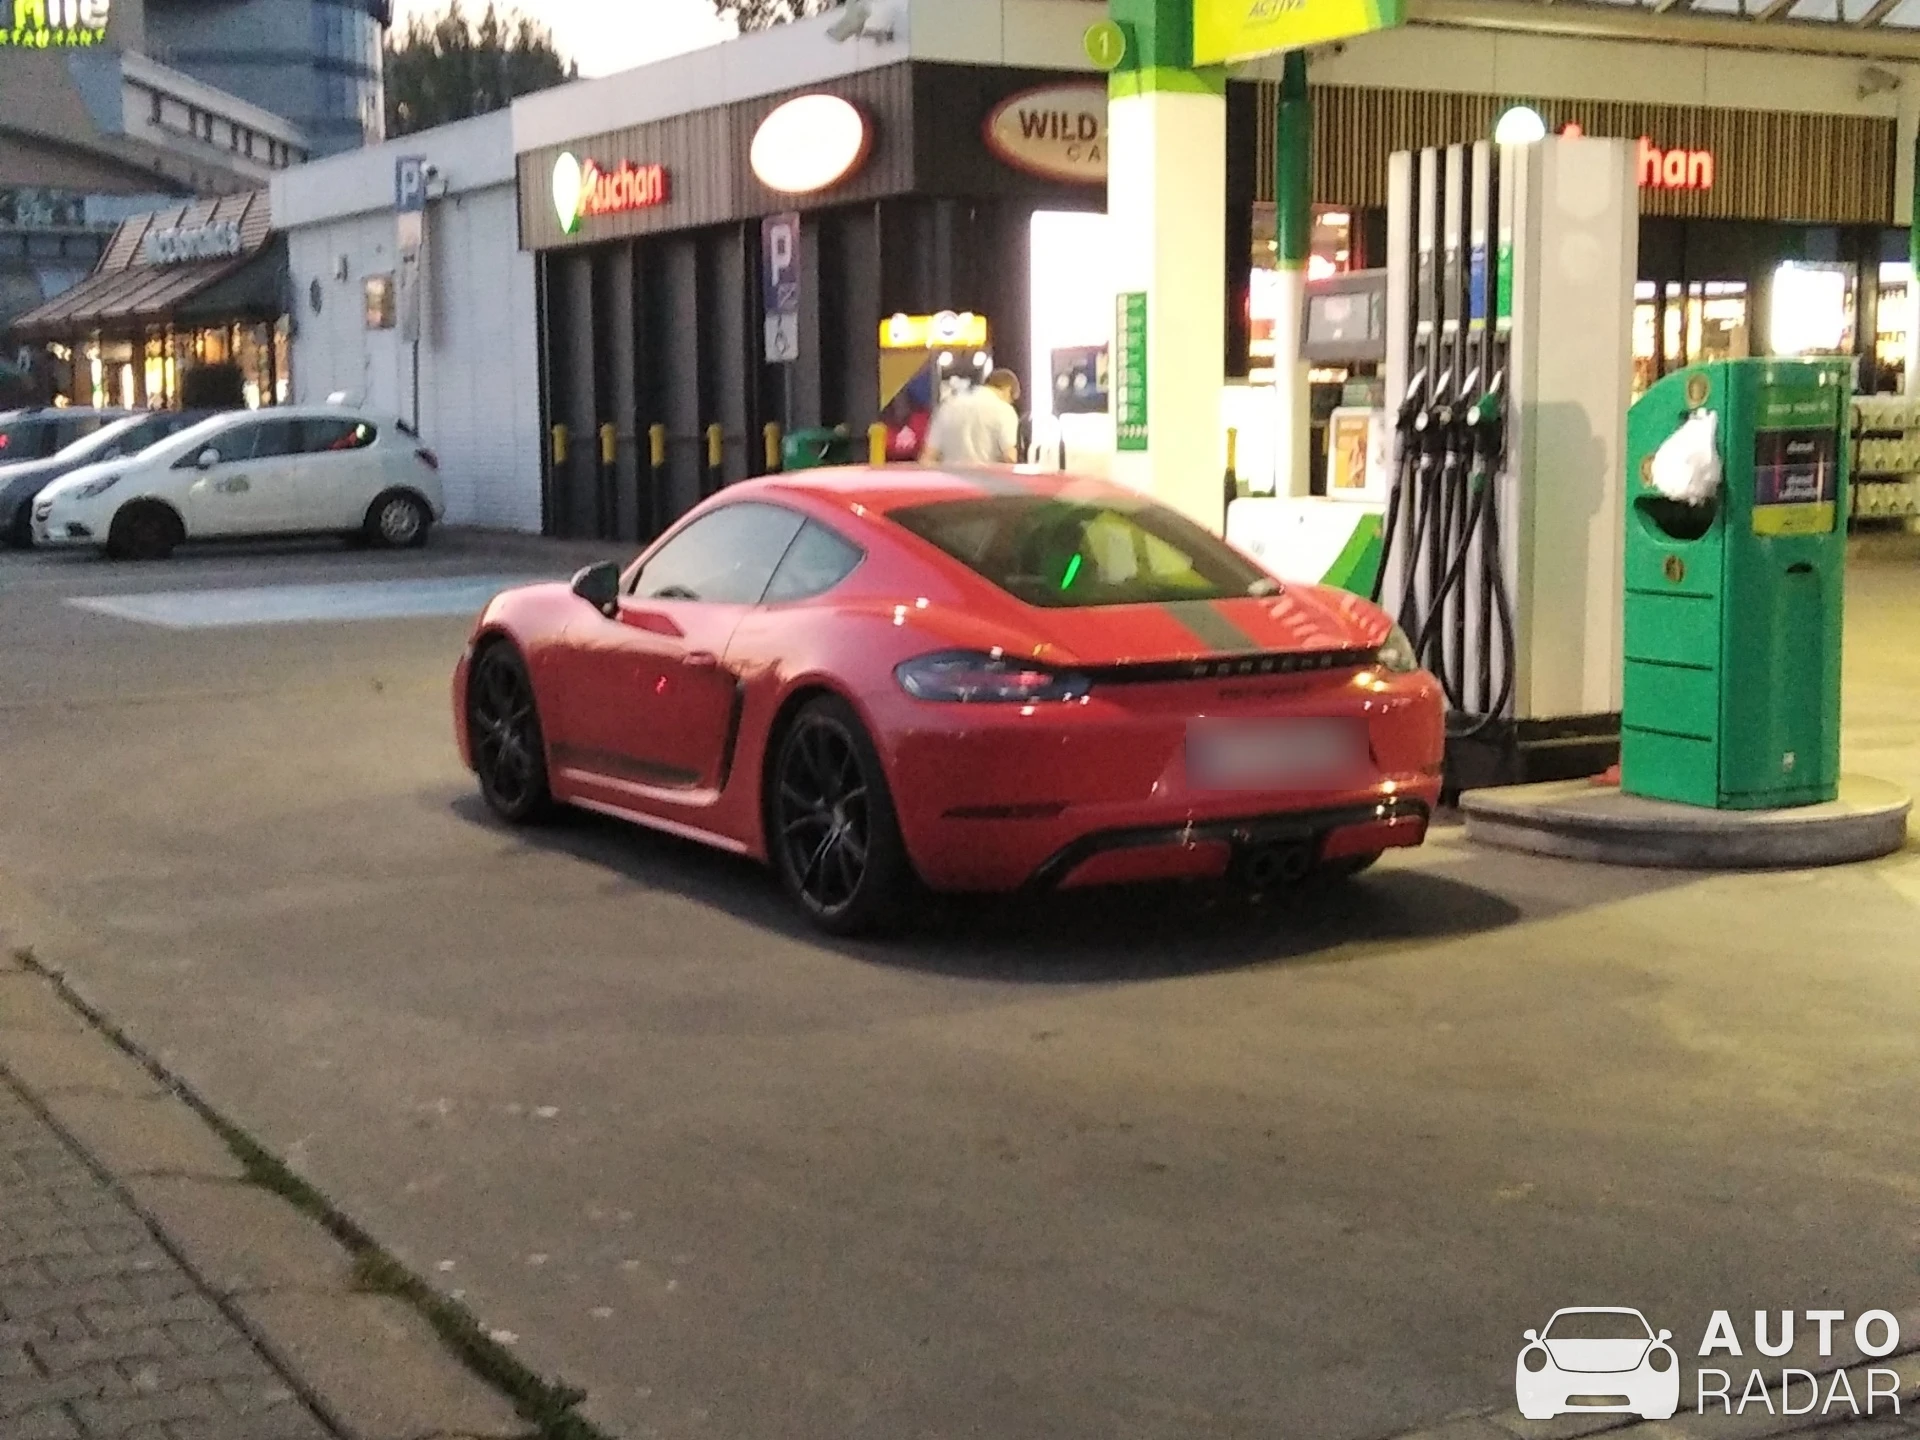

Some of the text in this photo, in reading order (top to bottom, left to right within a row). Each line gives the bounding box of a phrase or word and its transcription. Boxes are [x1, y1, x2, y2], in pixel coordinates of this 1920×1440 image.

[1097, 33, 1109, 58] 1
[1019, 109, 1098, 141] WILD
[1067, 145, 1101, 163] CA
[1638, 134, 1715, 189] han
[401, 162, 420, 205] P
[577, 158, 663, 217] Auchan
[770, 223, 792, 287] P
